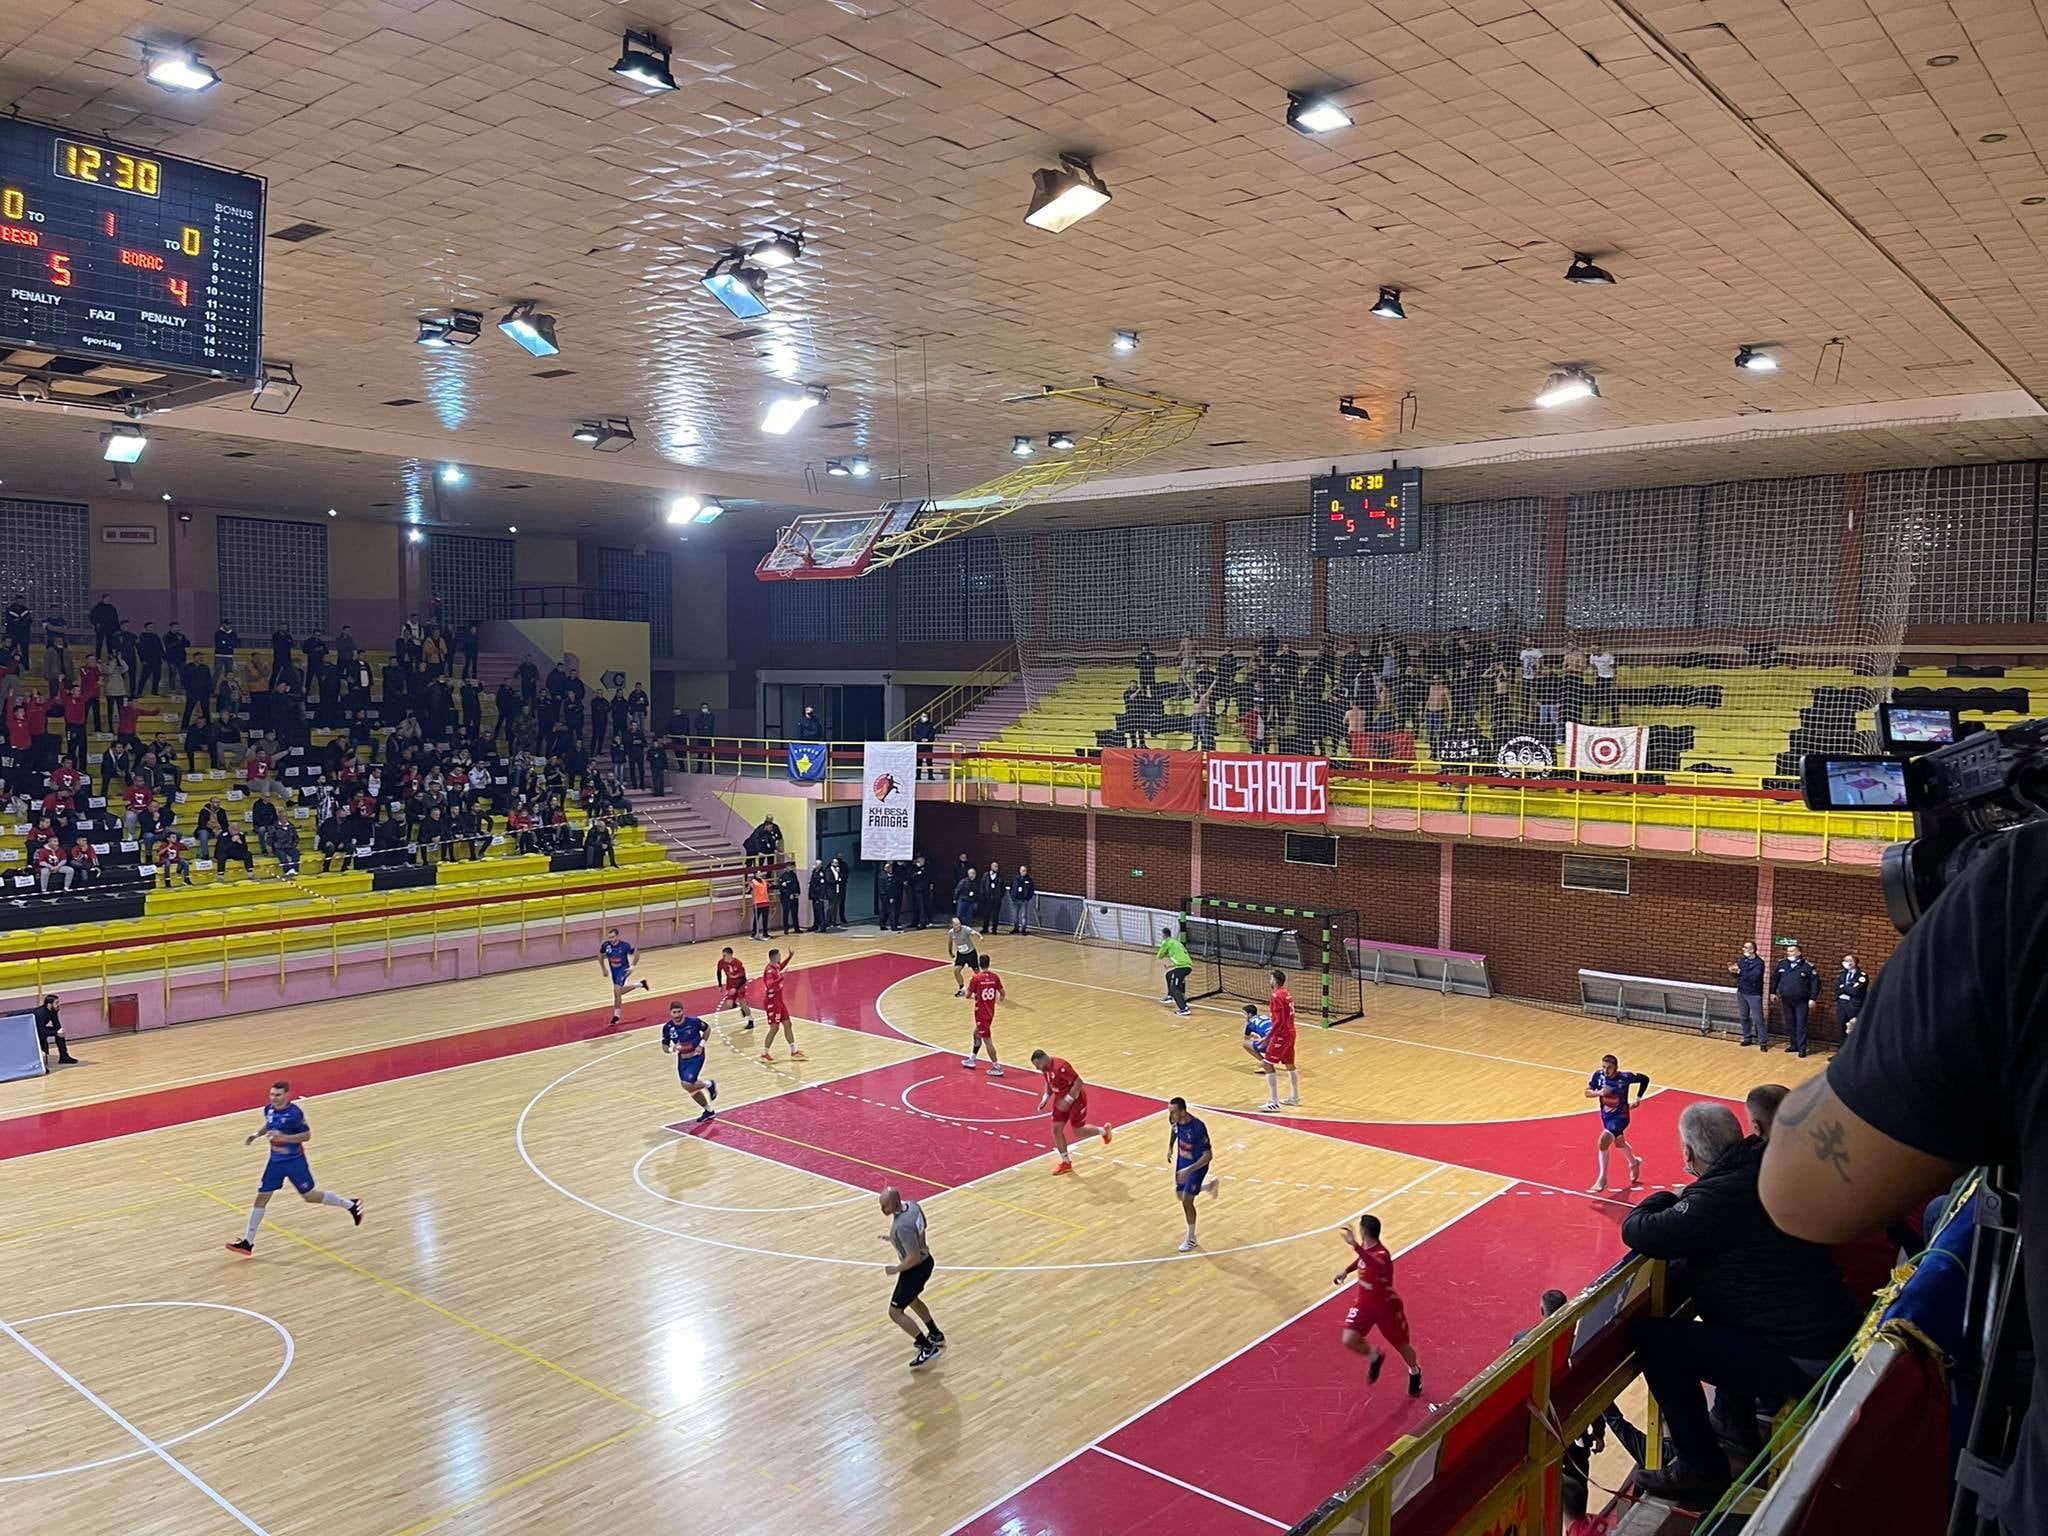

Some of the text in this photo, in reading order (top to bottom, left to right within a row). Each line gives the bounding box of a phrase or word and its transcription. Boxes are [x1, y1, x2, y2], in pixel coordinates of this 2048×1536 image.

[66, 146, 158, 195] 12:30
[3, 189, 24, 220] 0
[27, 210, 45, 222] TO
[214, 213, 221, 222] 4
[215, 203, 254, 220] BONUS
[214, 226, 220, 234] 5
[164, 239, 180, 251] TO
[182, 227, 201, 256] 0
[213, 238, 220, 247] 6
[121, 249, 164, 271] BORAC
[213, 250, 219, 259] 7
[50, 253, 72, 286] 5
[212, 263, 219, 272] 8
[211, 275, 218, 284] 9
[11, 288, 61, 305] PENALTY
[169, 277, 188, 307] 4
[206, 286, 218, 296] 10
[206, 299, 218, 309] 11
[89, 308, 116, 321] FAZI
[141, 311, 187, 327] PENALTY
[204, 311, 217, 321] 12
[204, 323, 216, 333] 13
[82, 336, 122, 351] sporting
[203, 336, 216, 345] 14
[203, 348, 216, 357] 15
[1350, 474, 1384, 490] 12:30
[1331, 500, 1340, 513] 0
[1346, 519, 1355, 532] 5
[1386, 517, 1395, 529] 4
[1210, 759, 1326, 814] BESA BOYS
[868, 807, 908, 816] KH BESA
[868, 815, 908, 828] FAMGAS
